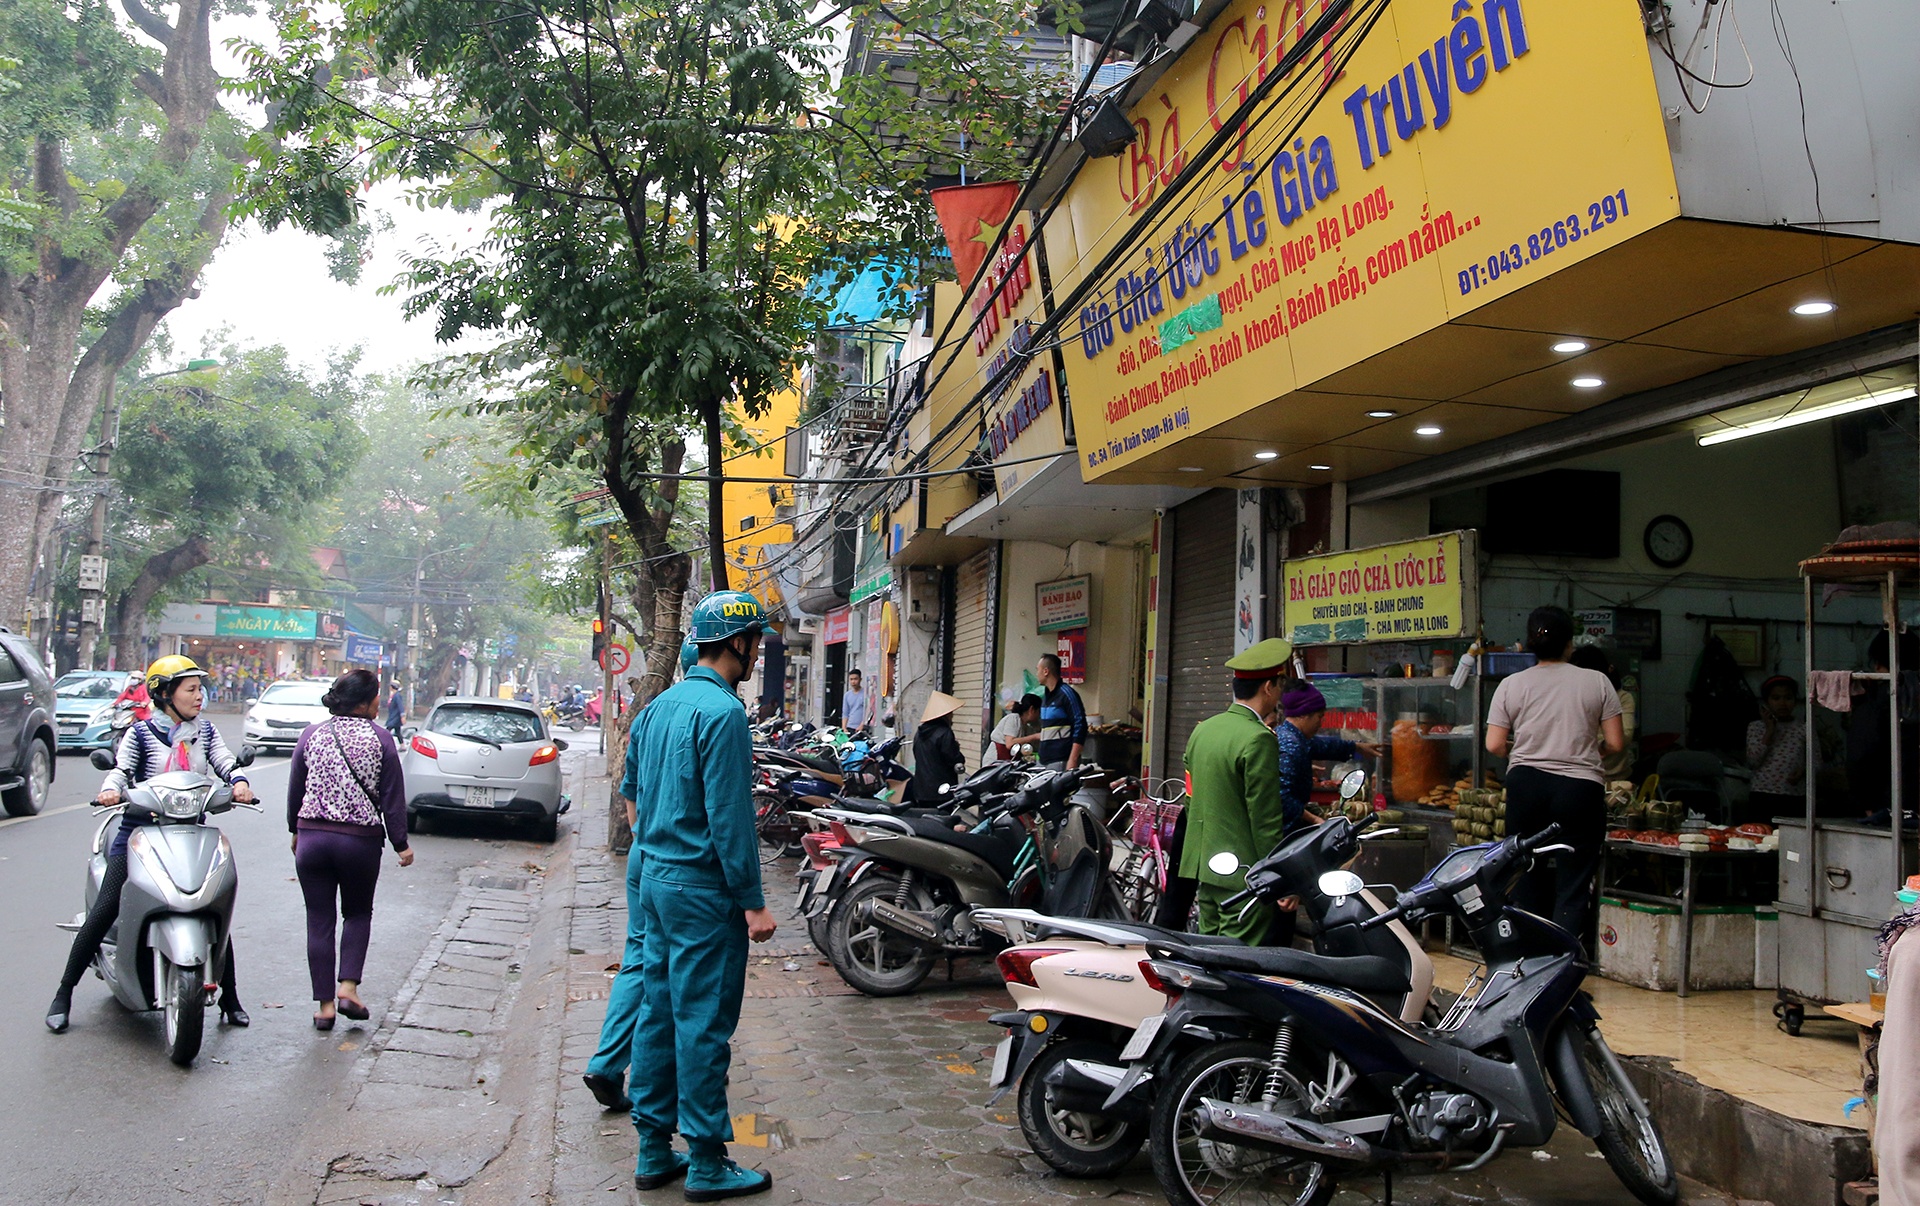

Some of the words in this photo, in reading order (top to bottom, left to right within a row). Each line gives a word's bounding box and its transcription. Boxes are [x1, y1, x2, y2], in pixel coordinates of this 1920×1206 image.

[1080, 290, 1114, 360] Giò
[1116, 246, 1165, 334] Chả
[1162, 219, 1220, 300] Ước
[1271, 135, 1341, 228] Gia
[1251, 247, 1280, 294] Chả
[1280, 235, 1316, 278] Mực
[1316, 217, 1341, 253] Hạ
[1342, 185, 1394, 238] Long.
[1457, 188, 1629, 296] ĐT:043.8263.291
[1107, 391, 1130, 425] Bánh
[1161, 361, 1190, 398] Bánh
[1190, 348, 1212, 386] giò,
[1210, 331, 1243, 373] Bánh
[1244, 305, 1288, 353] khoai,
[1287, 283, 1327, 330] Bánh
[1327, 256, 1367, 307] nếp,
[1366, 238, 1408, 285] cơm
[1107, 437, 1123, 460] Trần
[1123, 432, 1141, 453] Xuân
[1174, 406, 1190, 430] Nội
[1290, 570, 1306, 601] BÀ
[1308, 566, 1337, 599] GIÁP
[1339, 561, 1361, 595] GIÒ
[1364, 554, 1391, 592] CHẢ
[1394, 552, 1425, 588] ƯỚC
[1429, 541, 1447, 584] LỄ
[722, 602, 757, 617] DQTV
[1042, 592, 1064, 606] BÁNH
[1066, 590, 1082, 602] BAO
[1313, 602, 1338, 619] CHUYÊN
[1340, 600, 1351, 617] GIÒ
[1353, 597, 1368, 615] CHẢ
[1374, 598, 1395, 614] BÁNH
[235, 616, 271, 631] NGÀY
[1376, 614, 1393, 634] CHẢ
[1394, 617, 1412, 636] MỰC
[1414, 617, 1425, 635] HẠ
[1427, 615, 1449, 631] LONG
[1063, 967, 1135, 982] LEAD
